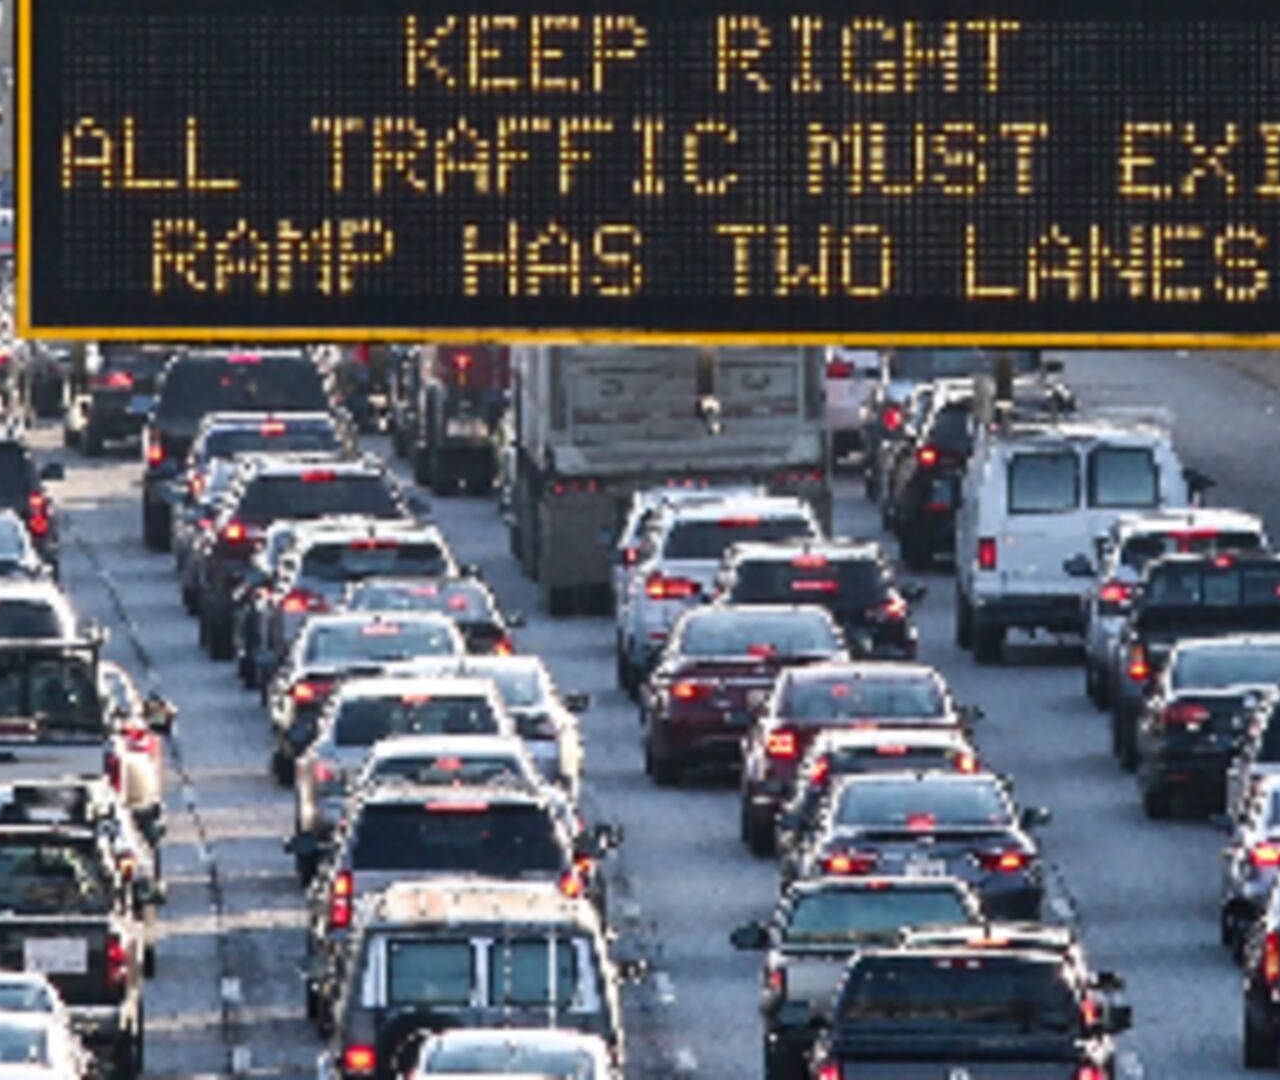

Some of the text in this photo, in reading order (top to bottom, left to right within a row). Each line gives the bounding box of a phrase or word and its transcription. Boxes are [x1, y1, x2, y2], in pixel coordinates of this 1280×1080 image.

[406, 16, 1020, 93] KEEP RIGHT
[62, 118, 239, 190] ALL
[312, 119, 738, 195] TRAFFIC
[808, 122, 1048, 196] MUST
[152, 220, 1269, 301] RAMP HAS TWO LANES
